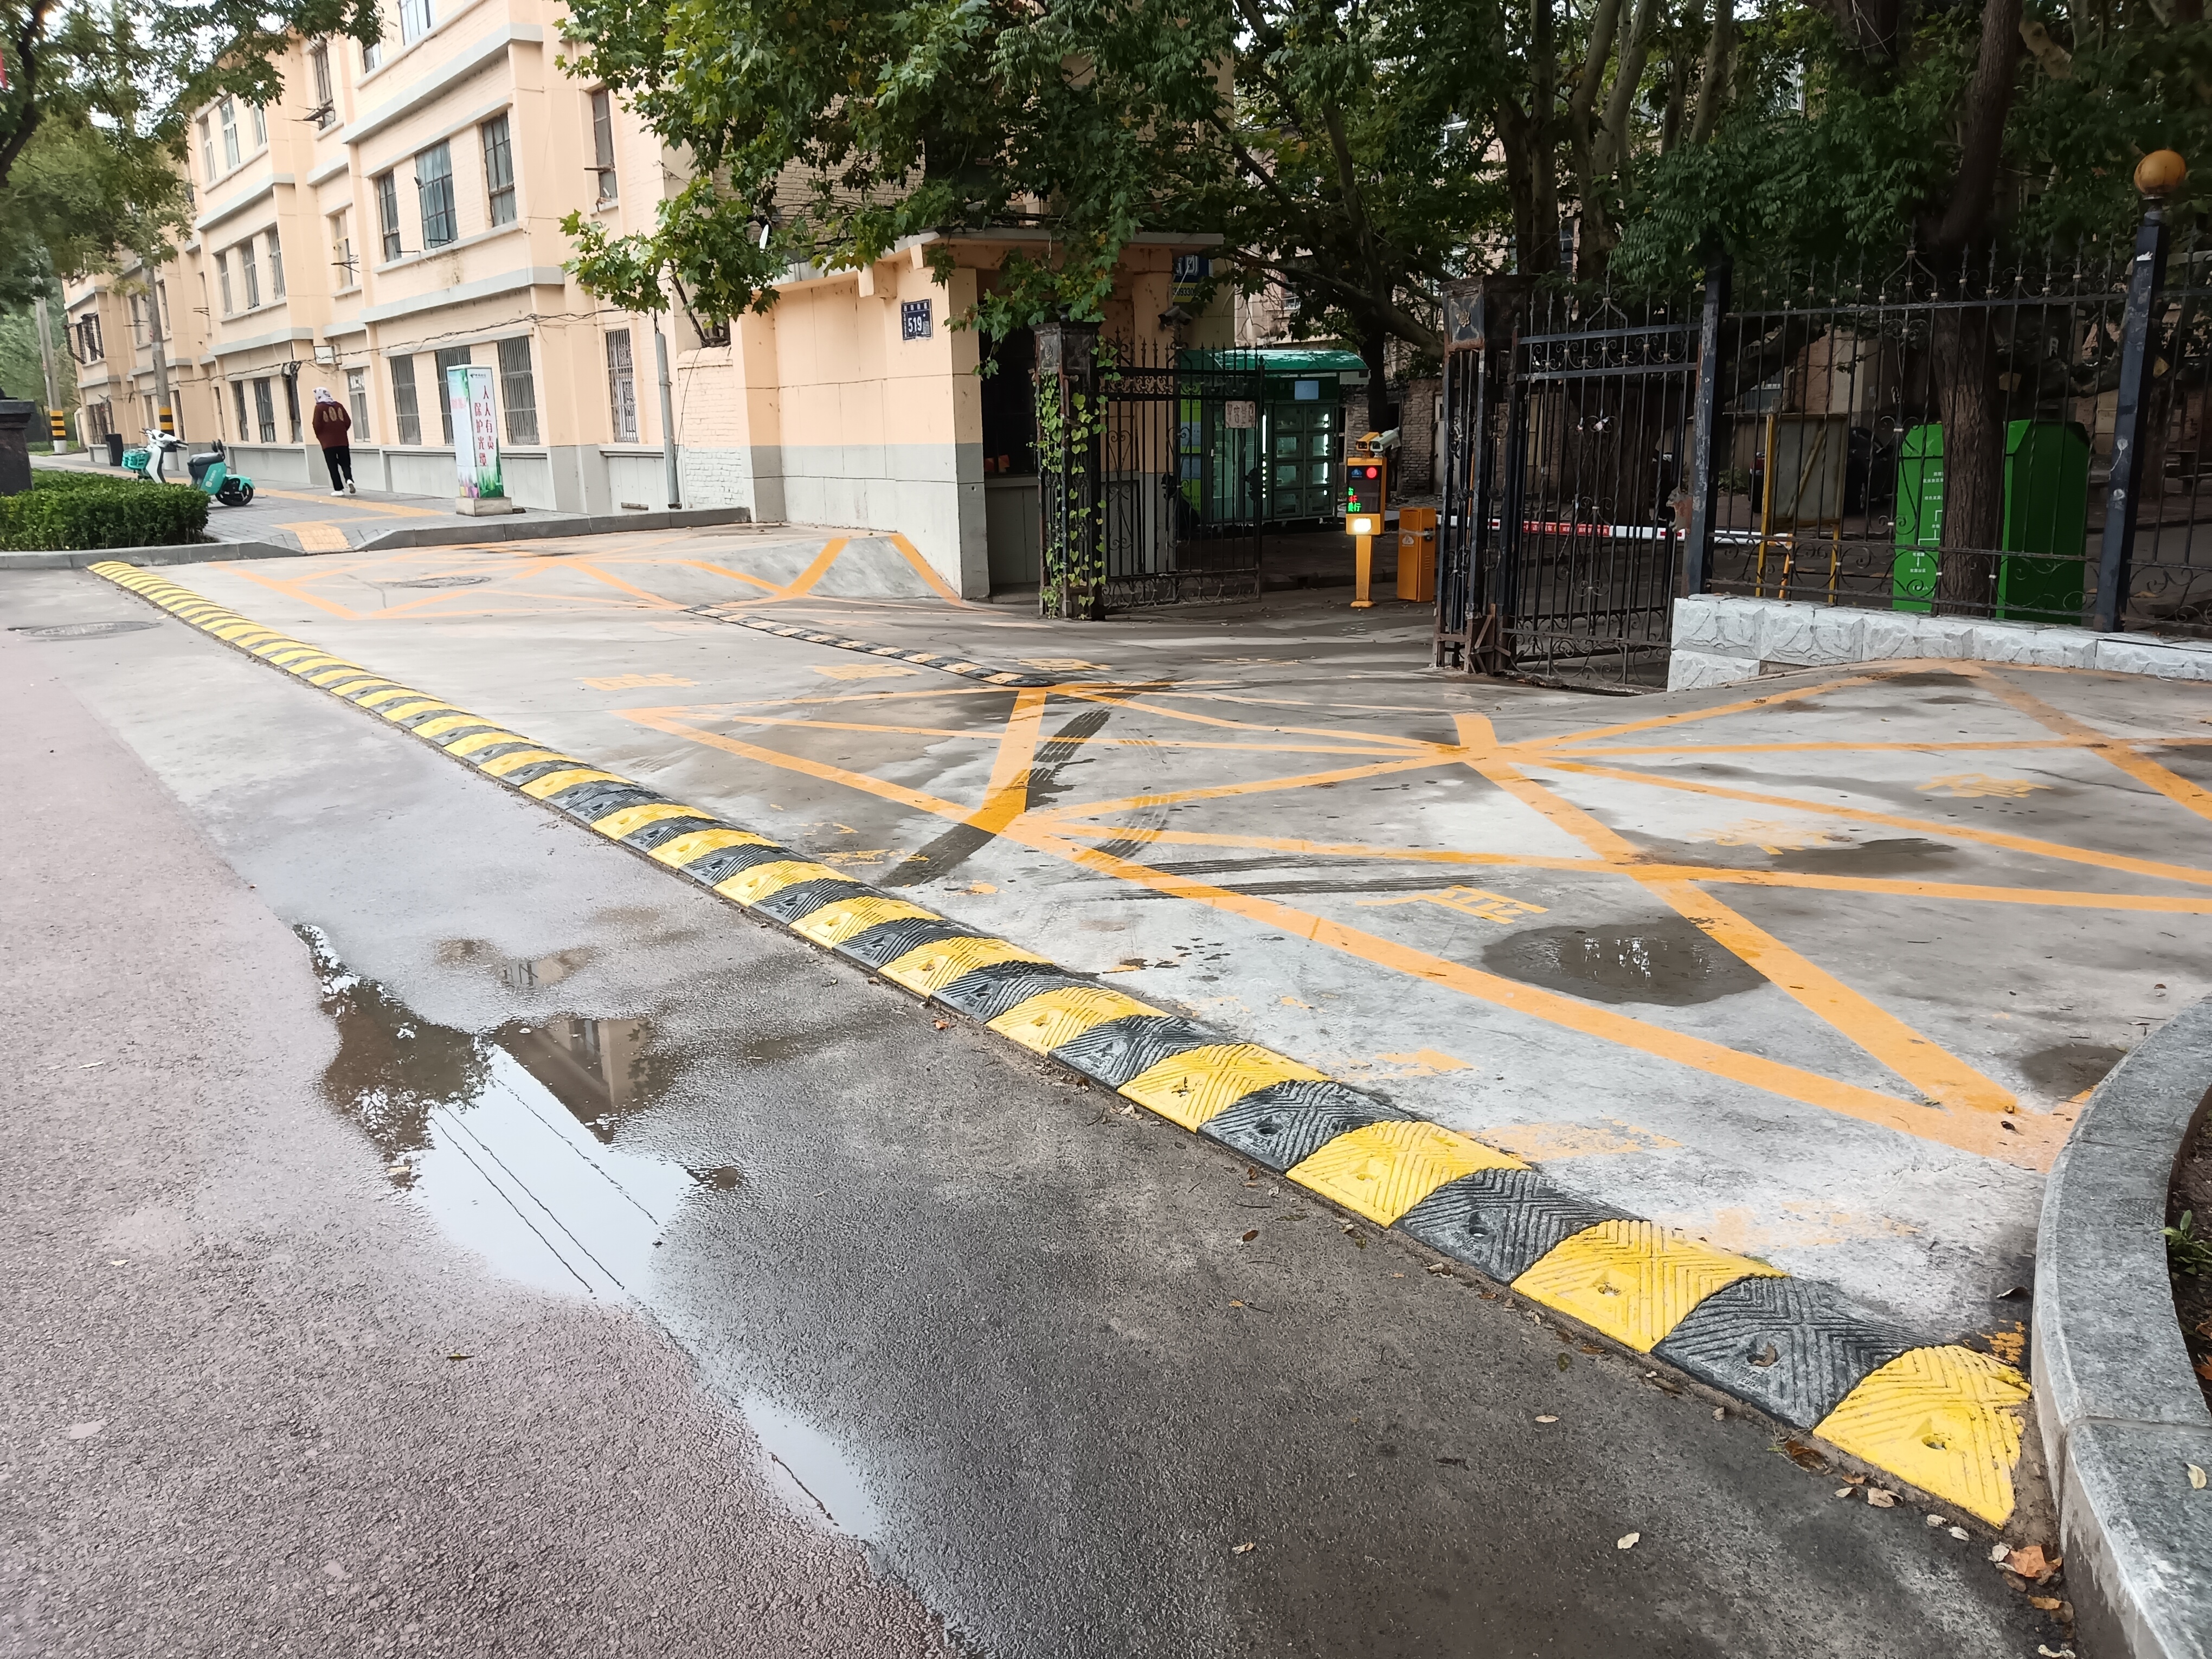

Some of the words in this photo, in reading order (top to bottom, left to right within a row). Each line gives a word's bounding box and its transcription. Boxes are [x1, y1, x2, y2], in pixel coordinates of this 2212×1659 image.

[908, 316, 922, 332] 519
[483, 385, 494, 450] 人人有责
